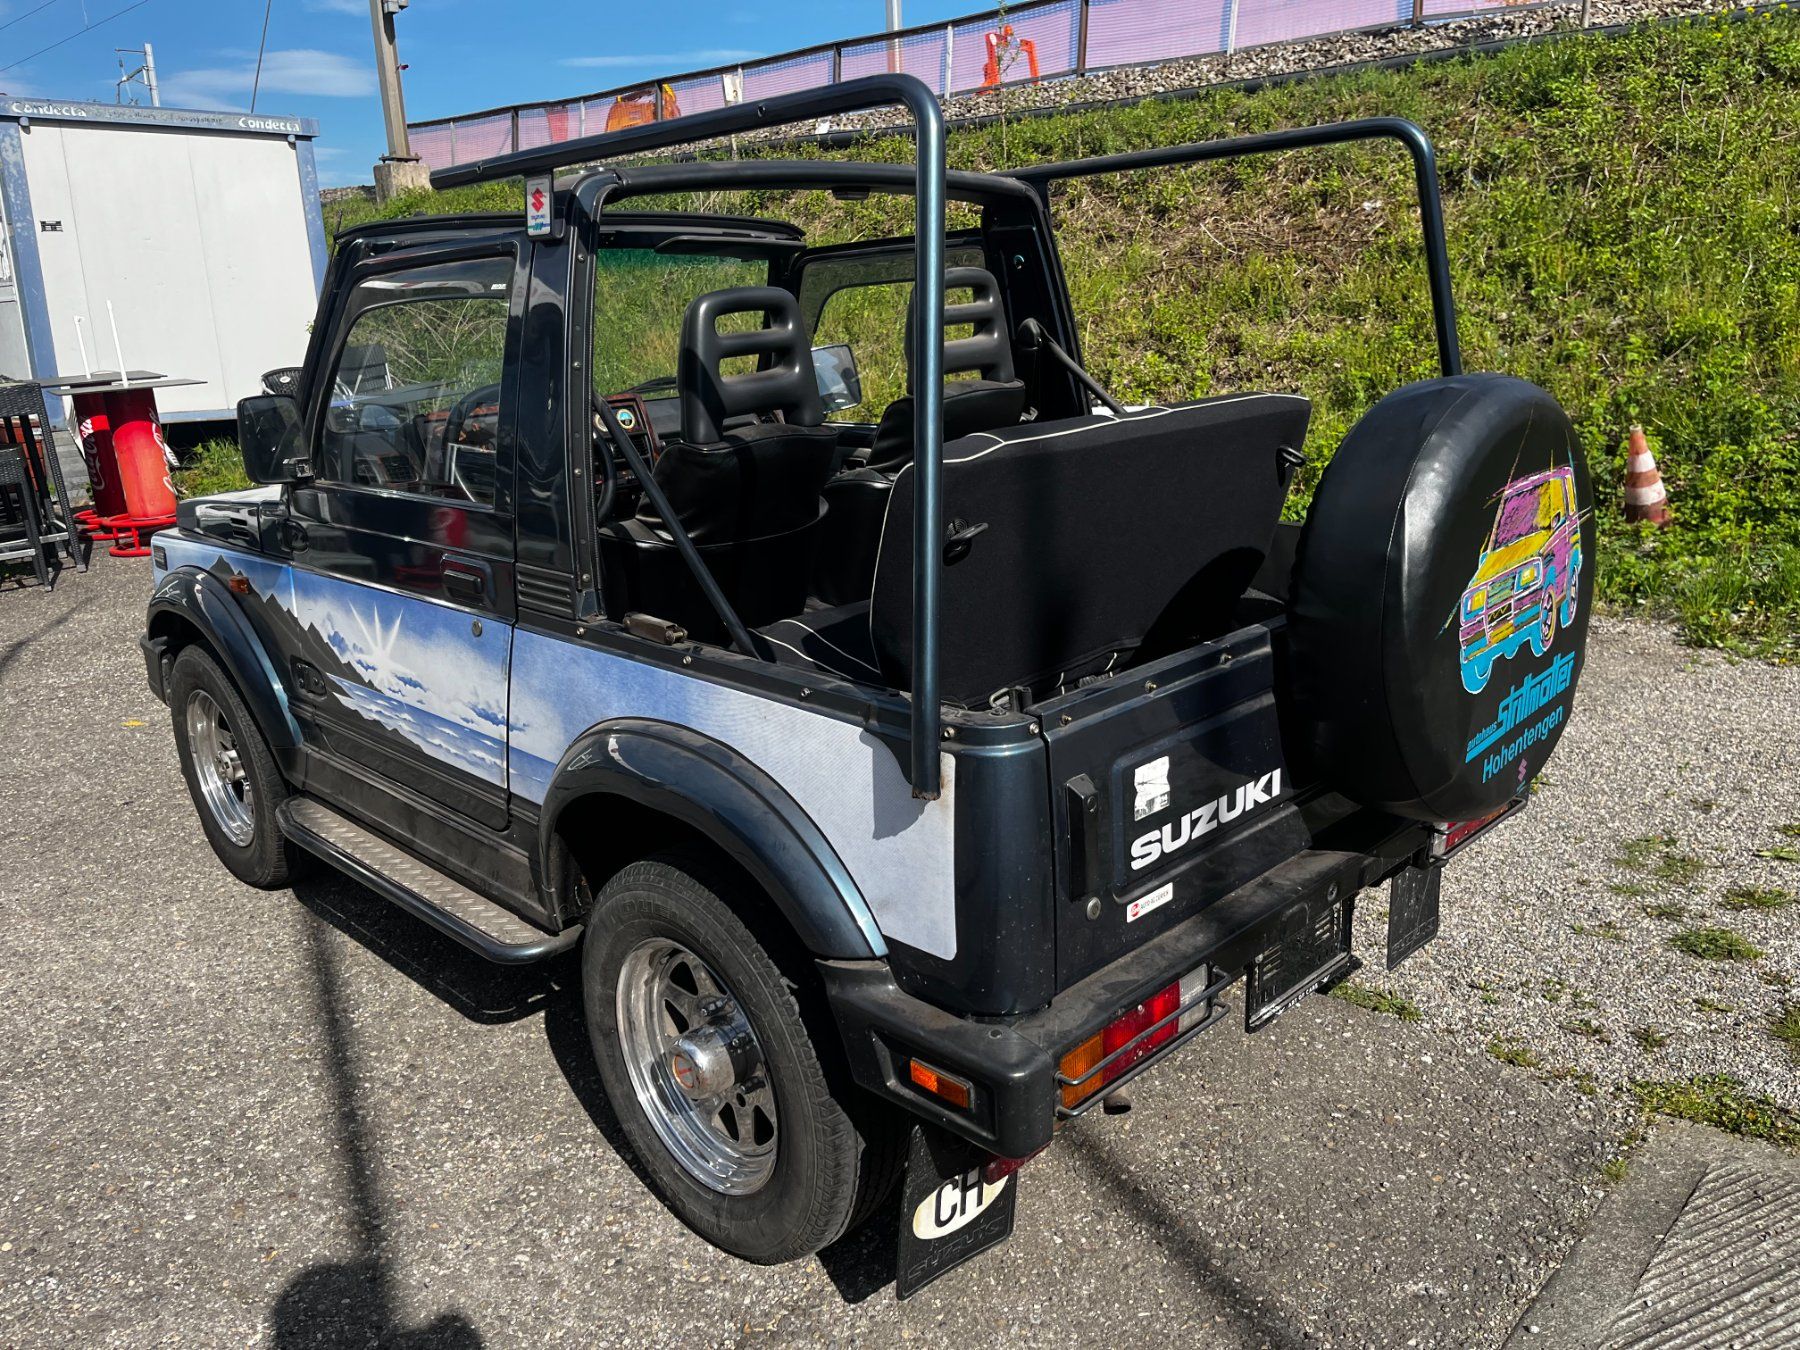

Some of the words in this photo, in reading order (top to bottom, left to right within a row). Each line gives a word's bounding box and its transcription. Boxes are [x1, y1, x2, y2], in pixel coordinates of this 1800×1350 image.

[12, 102, 87, 117] Condecta
[238, 117, 301, 132] Condecta
[1467, 721, 1498, 752] autohaus
[1482, 705, 1563, 783] Hohentengen
[1130, 768, 1281, 871] SUZUKI
[935, 1166, 985, 1228] CH
